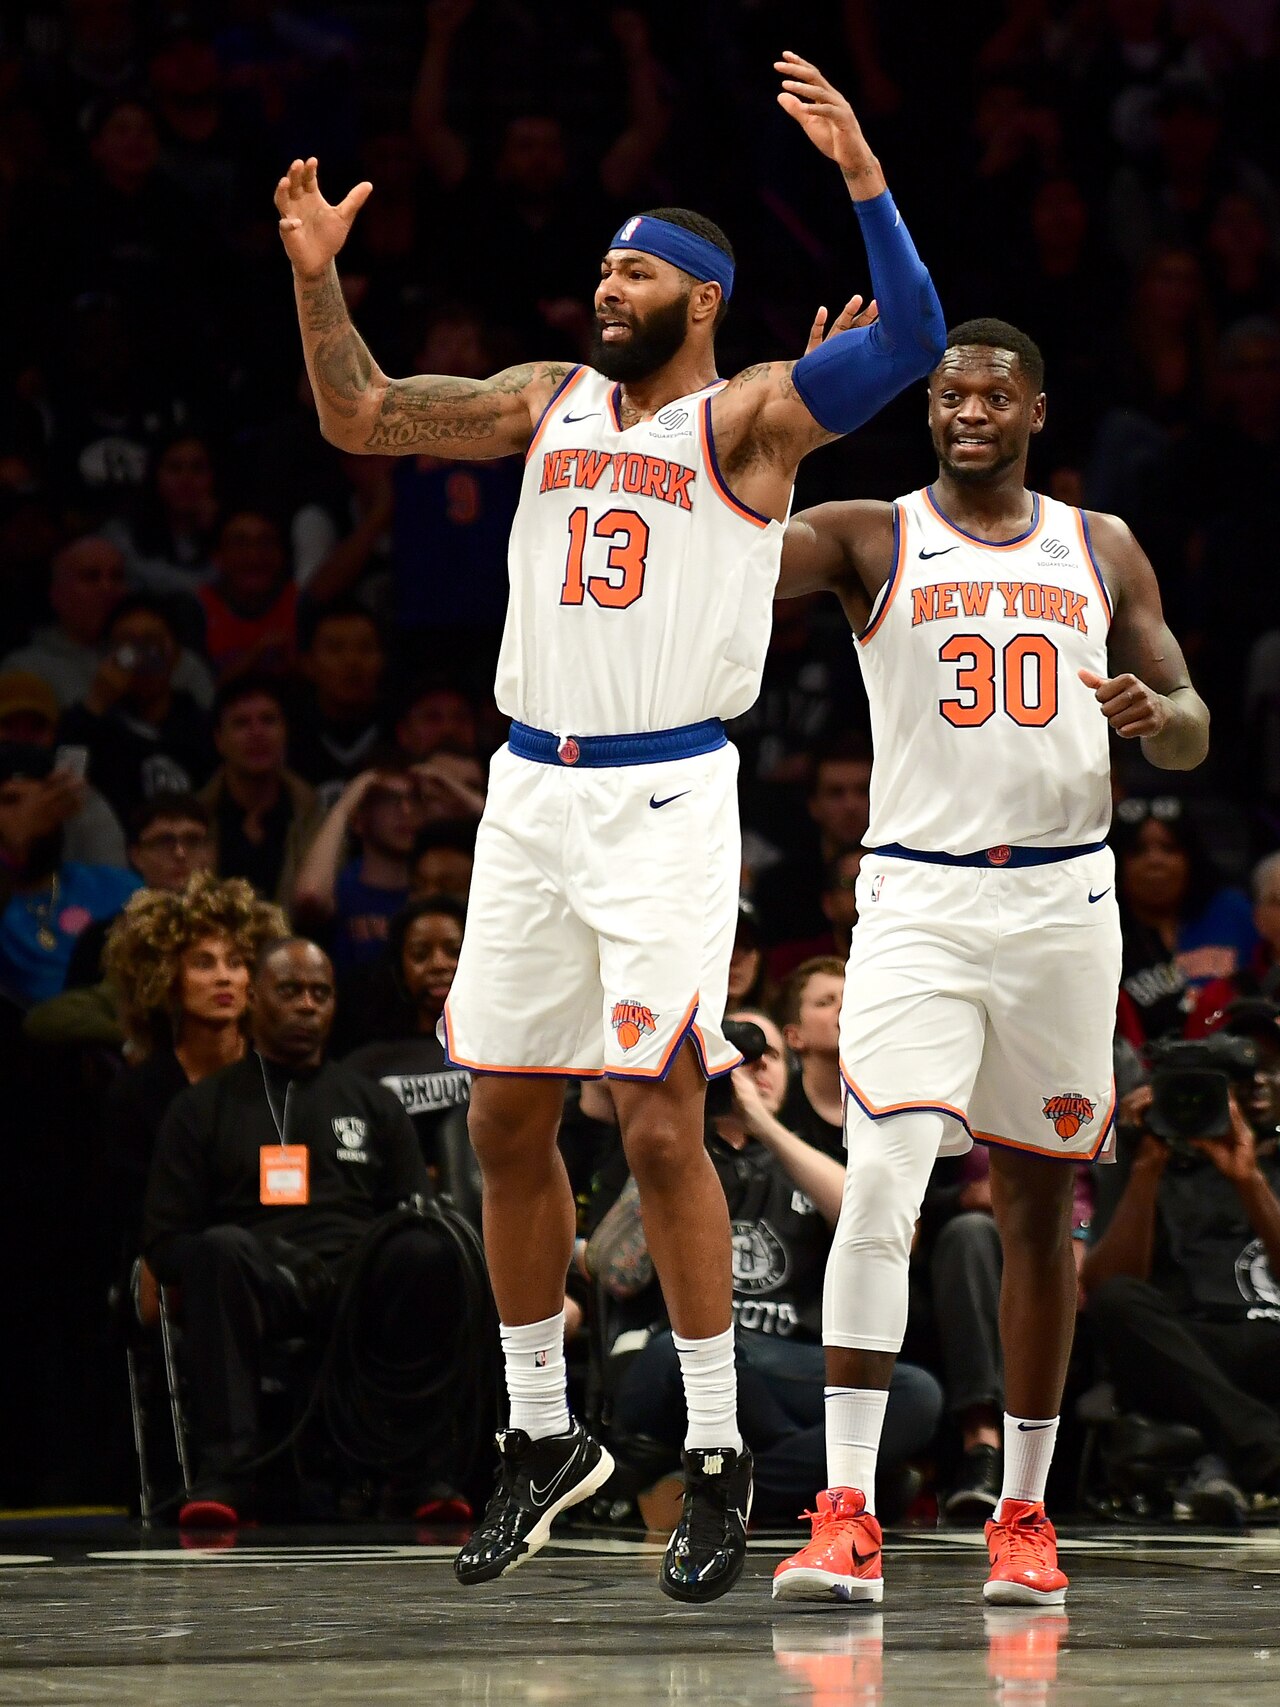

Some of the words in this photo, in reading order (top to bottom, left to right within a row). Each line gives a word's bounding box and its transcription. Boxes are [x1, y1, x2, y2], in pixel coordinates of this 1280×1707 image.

[539, 448, 612, 495] NEW
[610, 452, 697, 512] YORK
[559, 506, 650, 609] 13
[911, 582, 993, 628] NEW
[997, 582, 1088, 635] YORK
[939, 633, 1059, 728] 30
[1042, 1096, 1094, 1120] KNICKS
